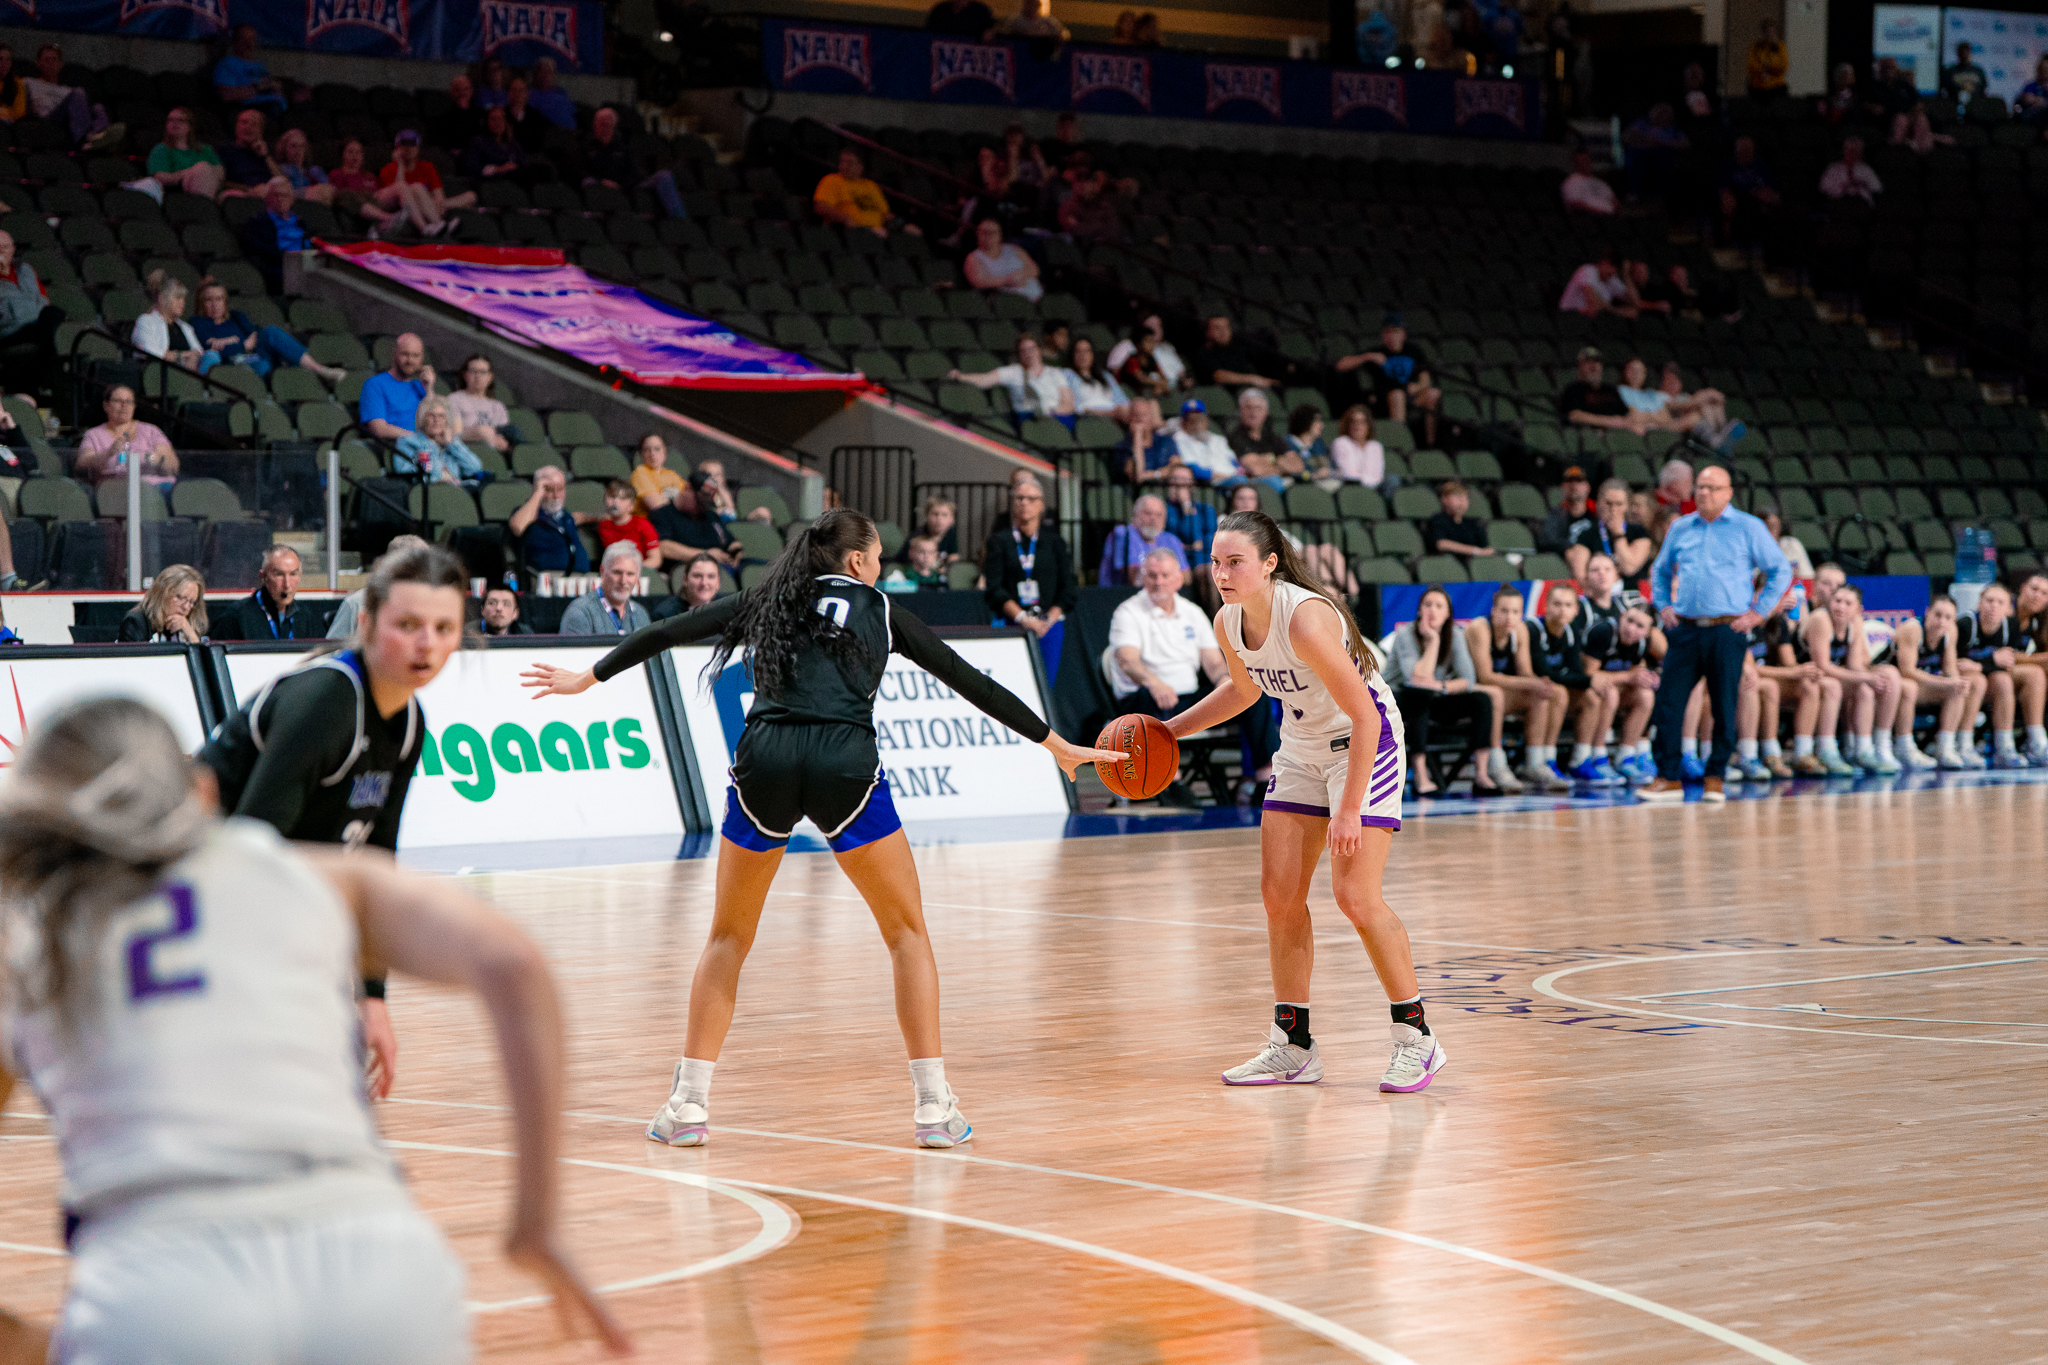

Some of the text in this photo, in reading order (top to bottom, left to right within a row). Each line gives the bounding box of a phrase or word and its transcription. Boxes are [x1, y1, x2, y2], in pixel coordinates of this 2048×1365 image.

[484, 4, 577, 60] NAIA
[784, 30, 869, 85] NAIA
[931, 42, 1012, 96] NAIA
[1072, 53, 1150, 110] NAIA
[877, 717, 1021, 750] ATIONAL
[887, 765, 959, 798] ANK
[123, 883, 206, 1003] 2
